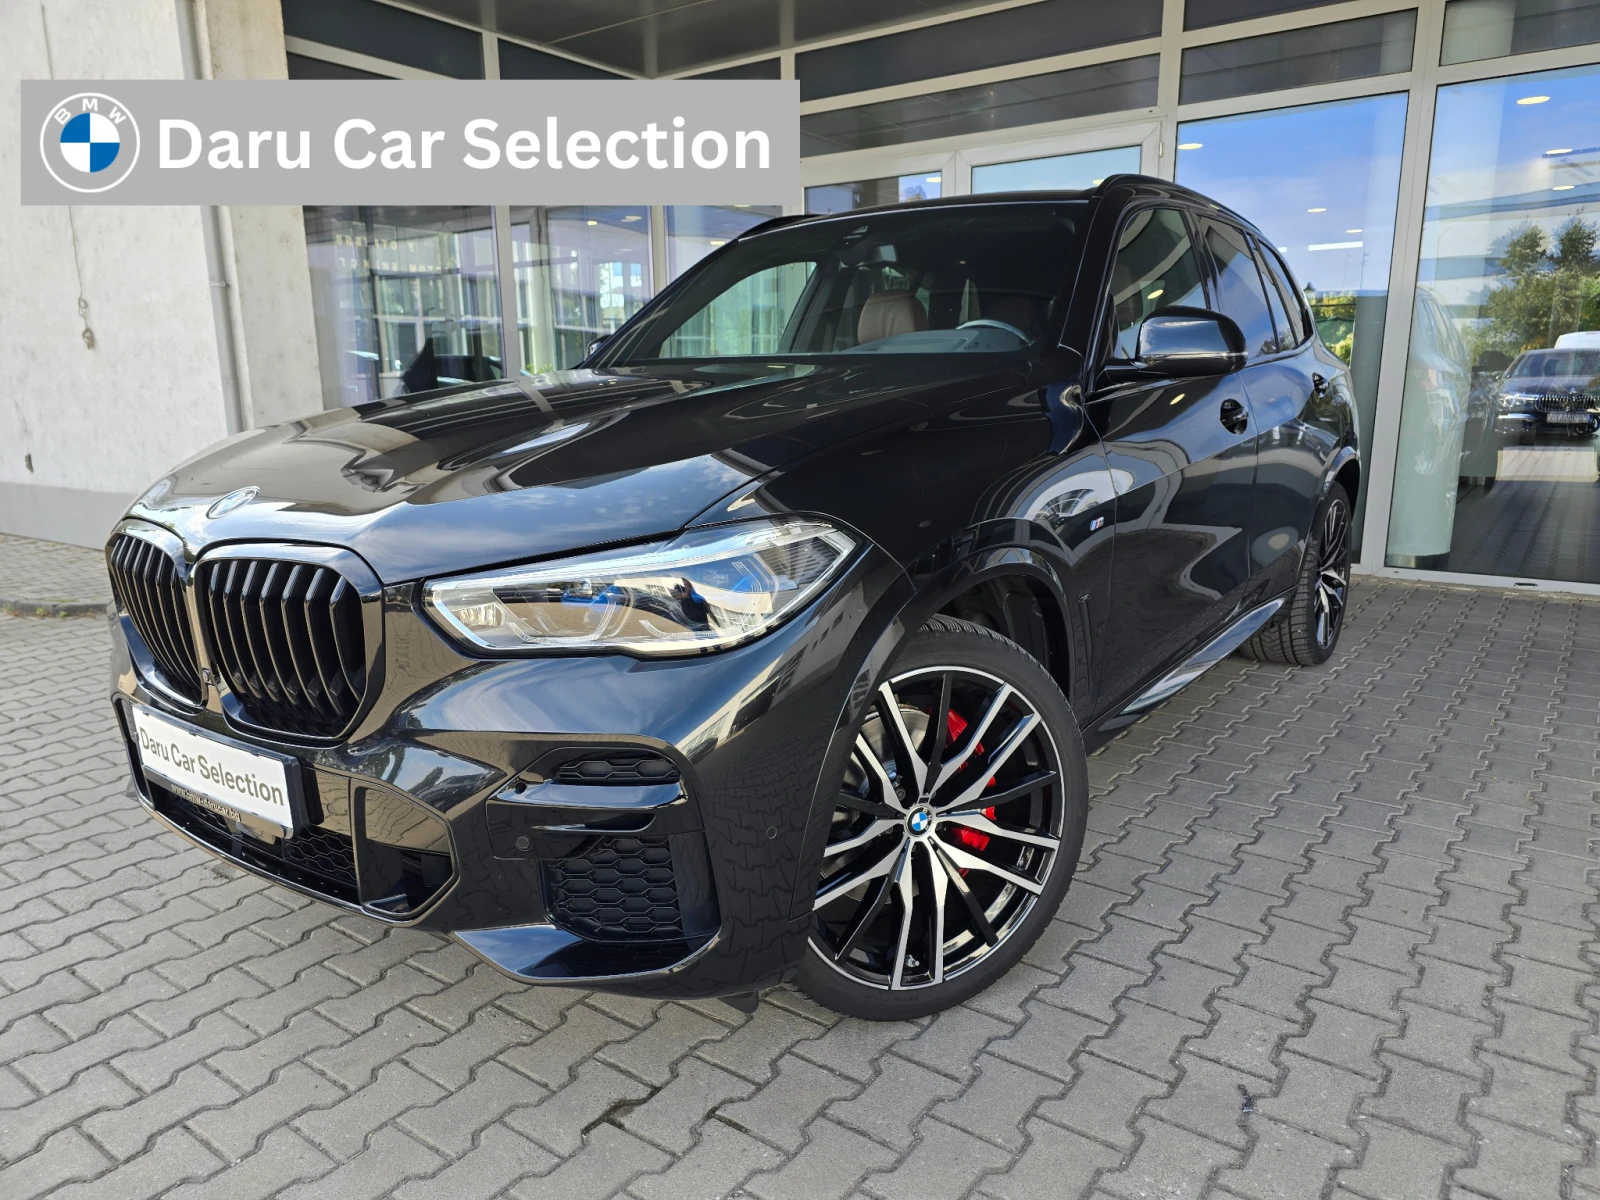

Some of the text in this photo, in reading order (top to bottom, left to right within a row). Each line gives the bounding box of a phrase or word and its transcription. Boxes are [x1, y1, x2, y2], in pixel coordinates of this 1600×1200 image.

[140, 727, 285, 806] Daru Car Selection
